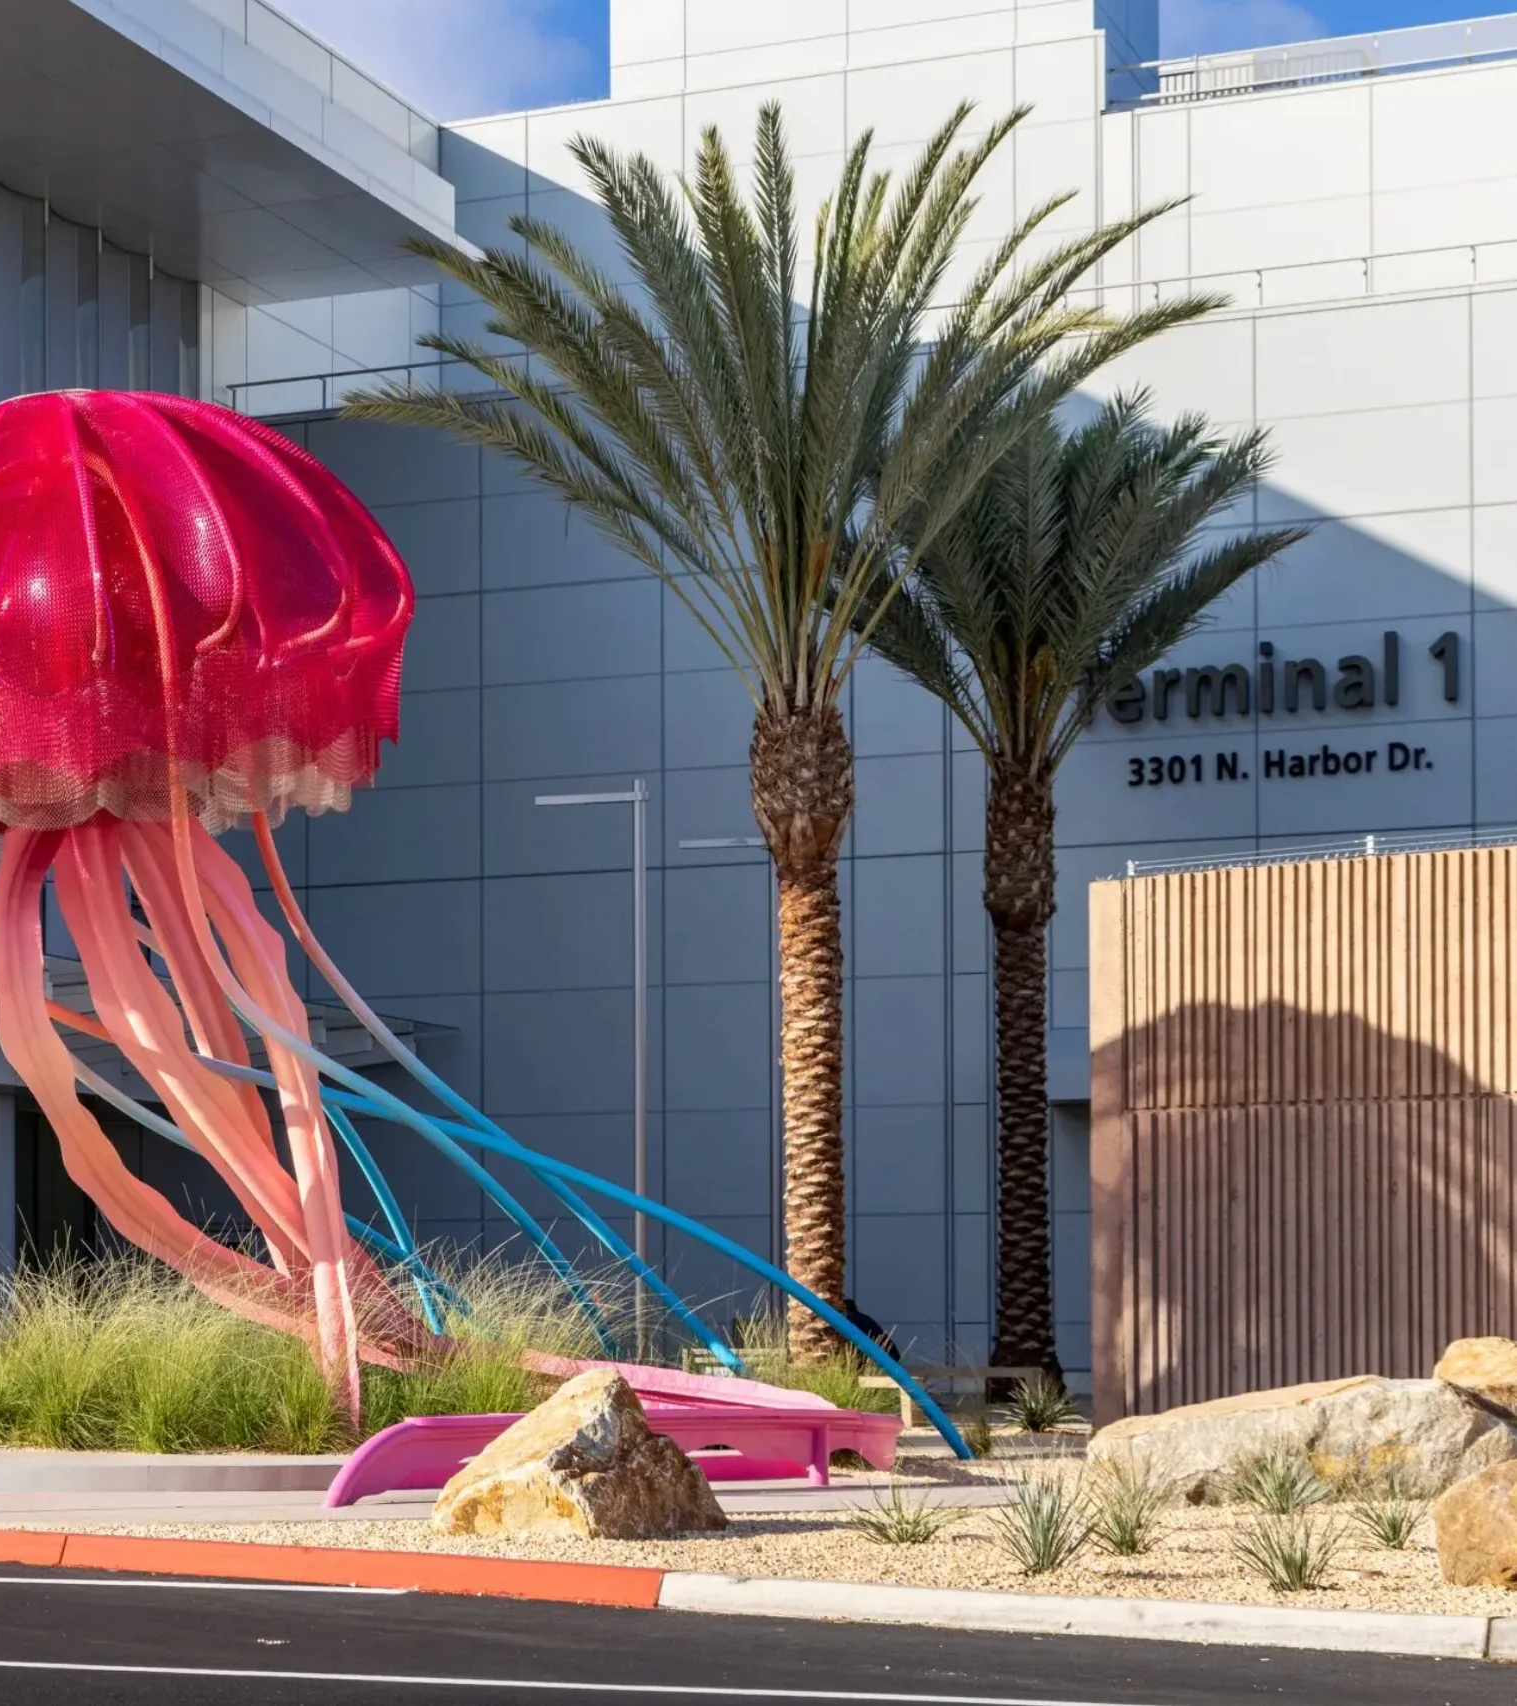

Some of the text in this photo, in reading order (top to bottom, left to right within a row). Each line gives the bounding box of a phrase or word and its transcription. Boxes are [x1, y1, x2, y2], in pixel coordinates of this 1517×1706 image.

[1428, 630, 1460, 704] 1
[1128, 741, 1434, 787] 3301 N. Harbor Dr.
